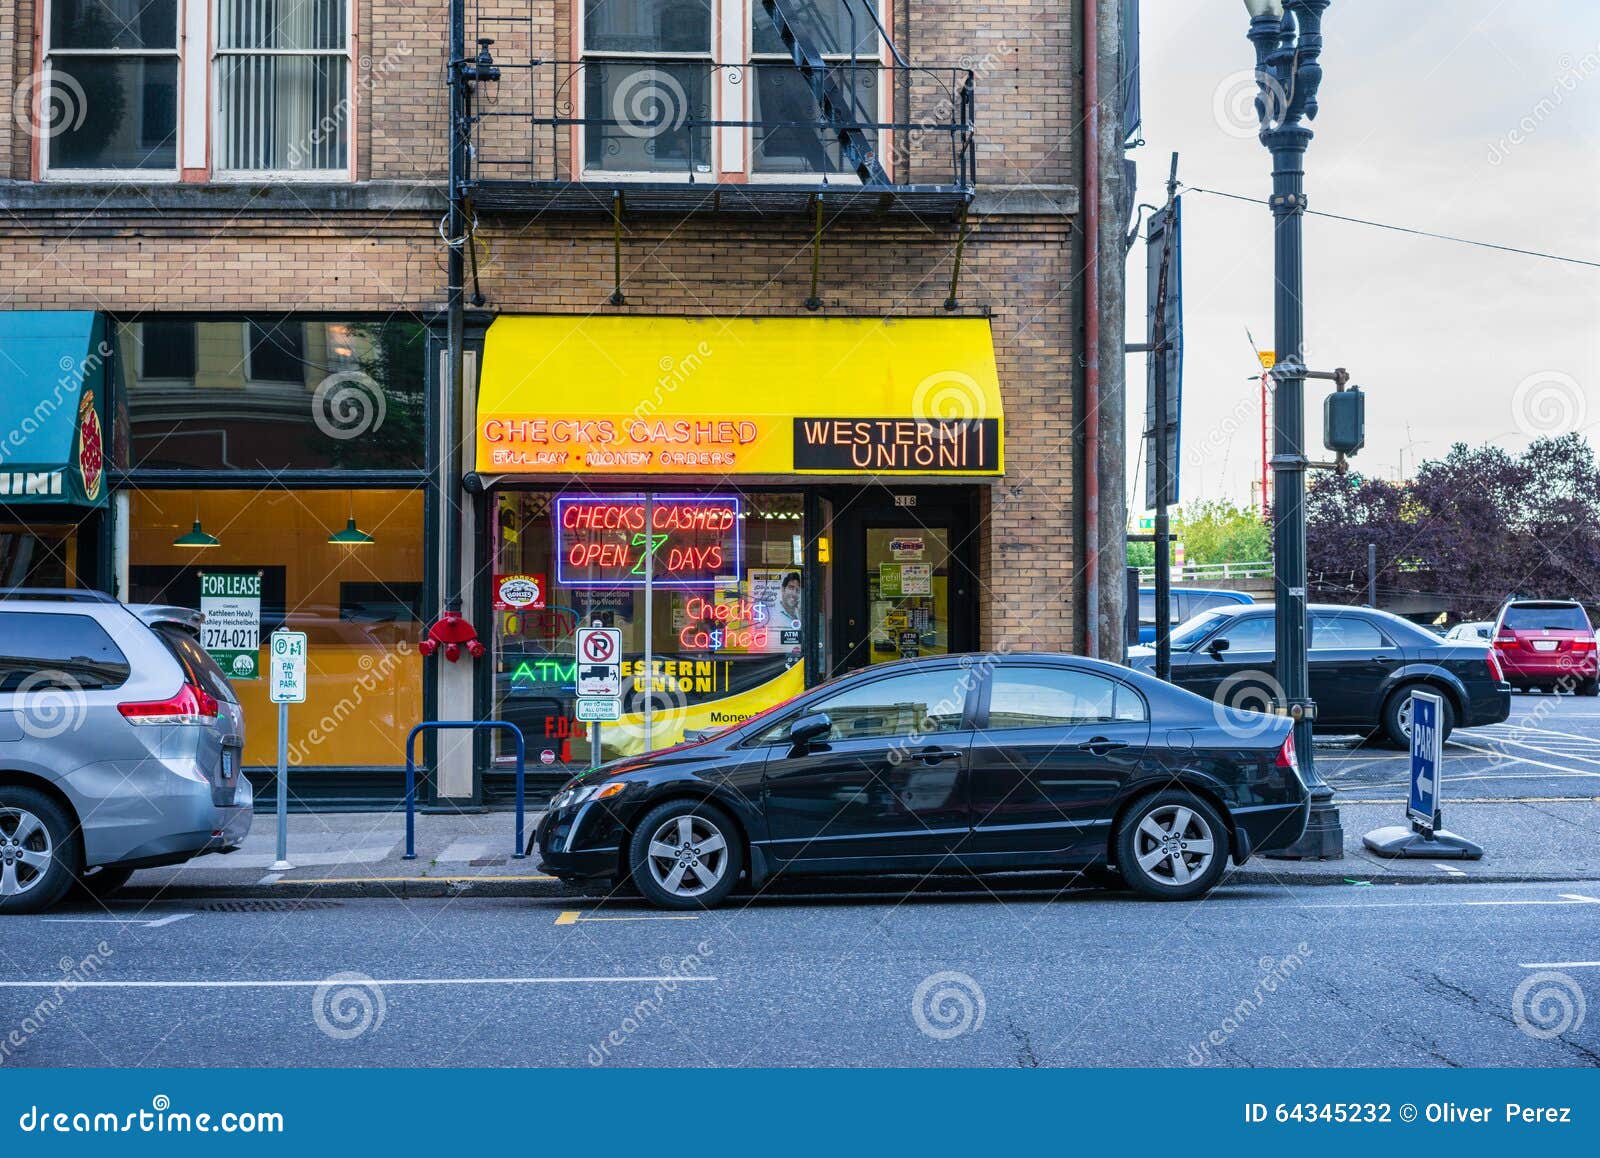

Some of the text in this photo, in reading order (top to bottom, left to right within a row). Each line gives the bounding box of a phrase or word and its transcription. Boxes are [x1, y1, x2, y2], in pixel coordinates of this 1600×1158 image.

[484, 420, 757, 444] CHECKS CASHED
[804, 421, 958, 445] WESTERN
[586, 451, 652, 465] MONEY
[660, 451, 736, 465] ORDERS
[852, 444, 958, 467] UNION
[563, 506, 733, 529] CHECKS CASHED
[569, 533, 722, 574] OPEN 7 DAYS
[202, 576, 261, 595] FOR LEASE
[236, 610, 253, 618] Healy
[506, 612, 575, 638] OPEN
[207, 629, 259, 648] 274-0211
[282, 662, 294, 671] PAY
[512, 662, 577, 682] ATM
[621, 660, 712, 676] ESTERN
[280, 680, 297, 688] PARK
[633, 677, 712, 693] UNION
